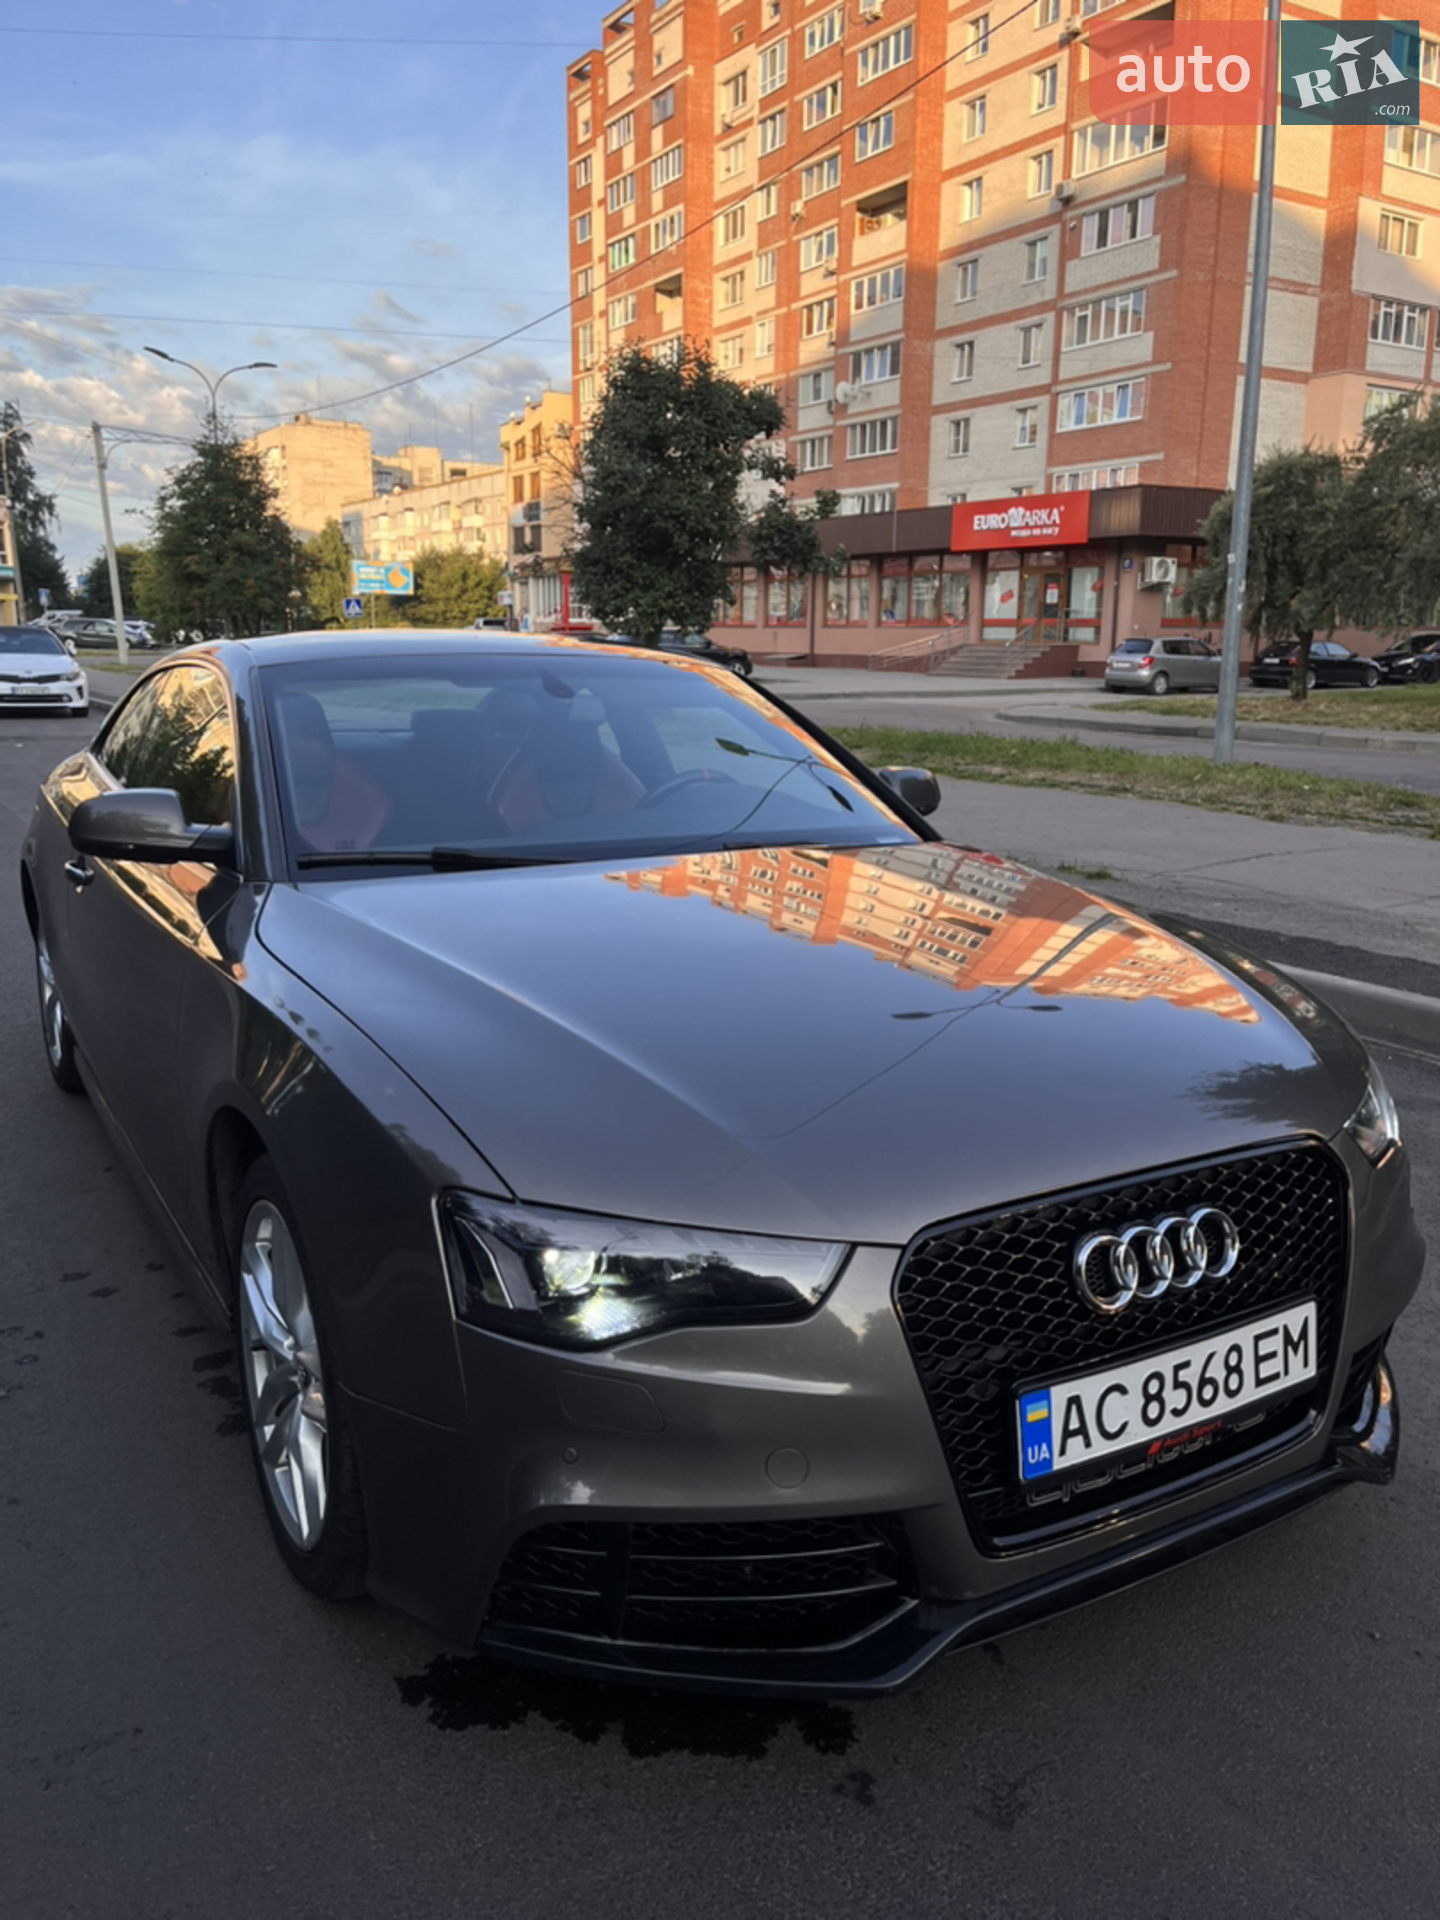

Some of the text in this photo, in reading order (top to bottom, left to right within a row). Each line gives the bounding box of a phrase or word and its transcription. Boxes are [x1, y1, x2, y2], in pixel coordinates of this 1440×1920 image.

[1058, 1383, 1130, 1458] AC
[1141, 1343, 1244, 1428] 8568
[1253, 1315, 1310, 1389] EM
[1027, 1442, 1050, 1464] UA
